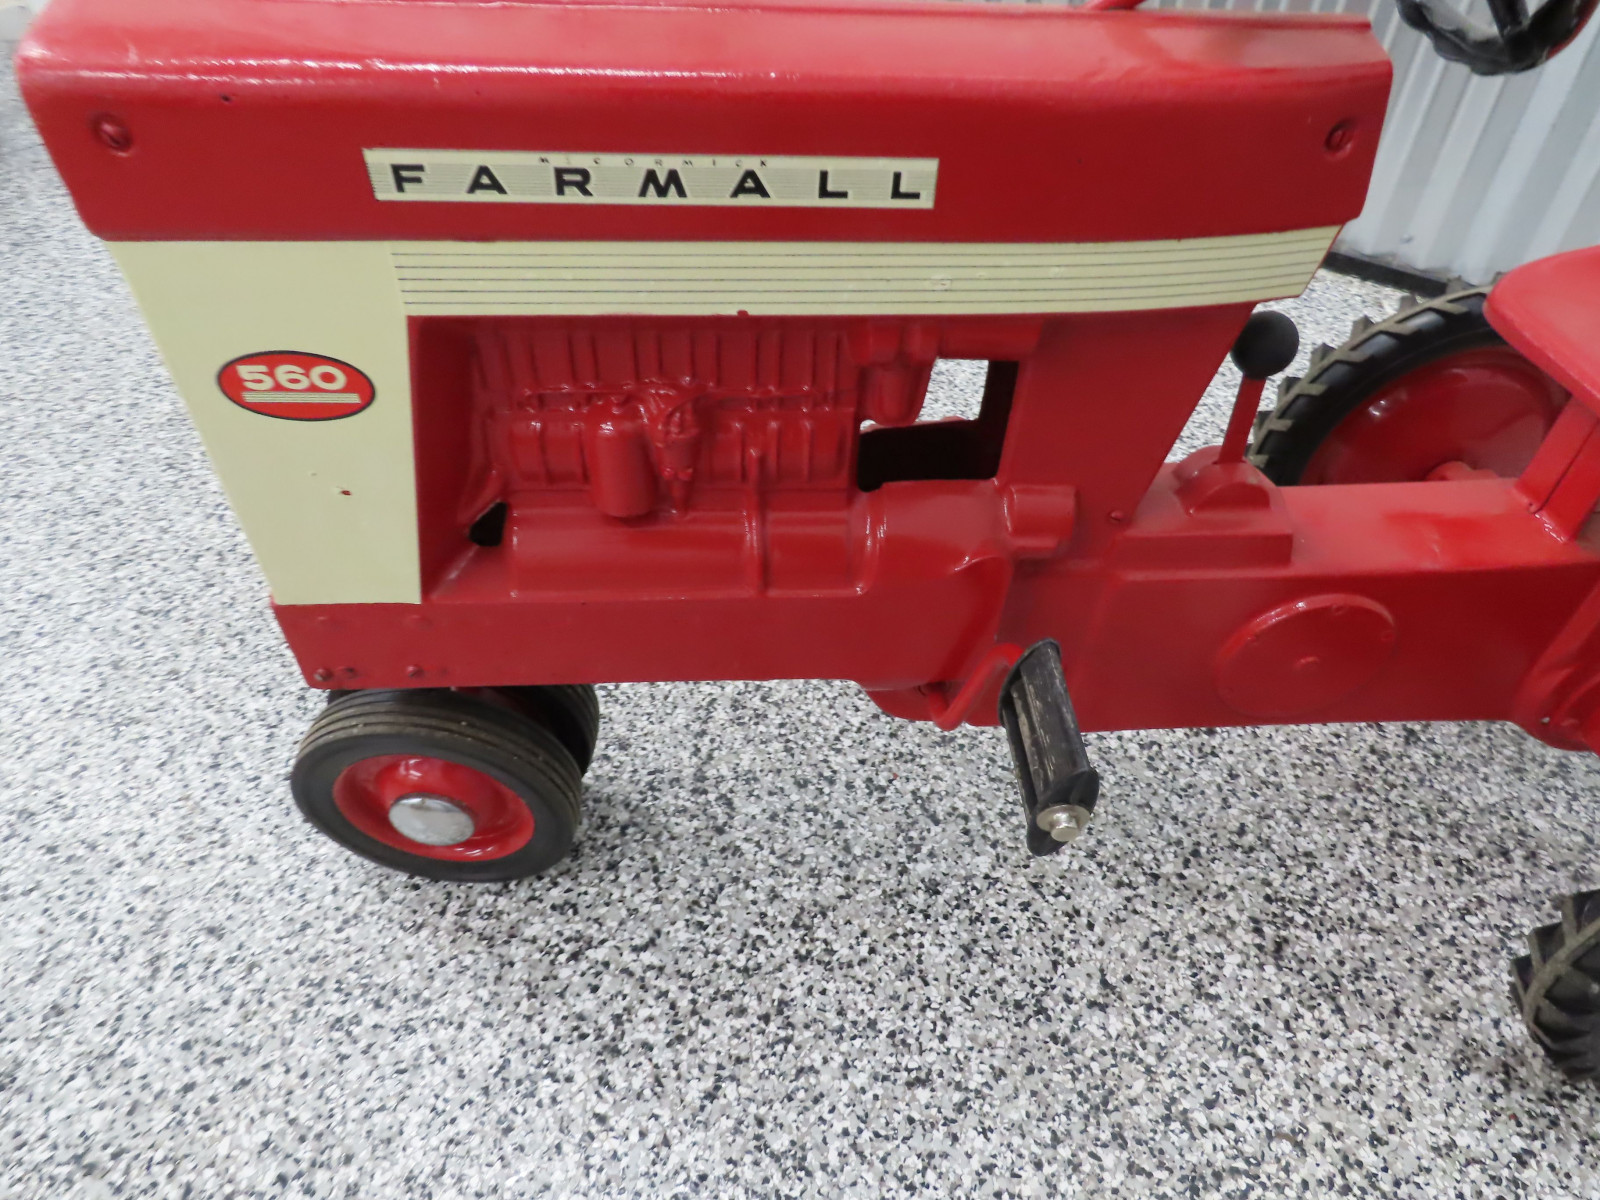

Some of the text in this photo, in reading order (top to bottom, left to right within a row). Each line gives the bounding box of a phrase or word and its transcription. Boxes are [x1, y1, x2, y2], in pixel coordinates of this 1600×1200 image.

[539, 156, 767, 167] MCORMICK
[390, 163, 921, 200] FARMALL
[236, 364, 347, 391] 560
